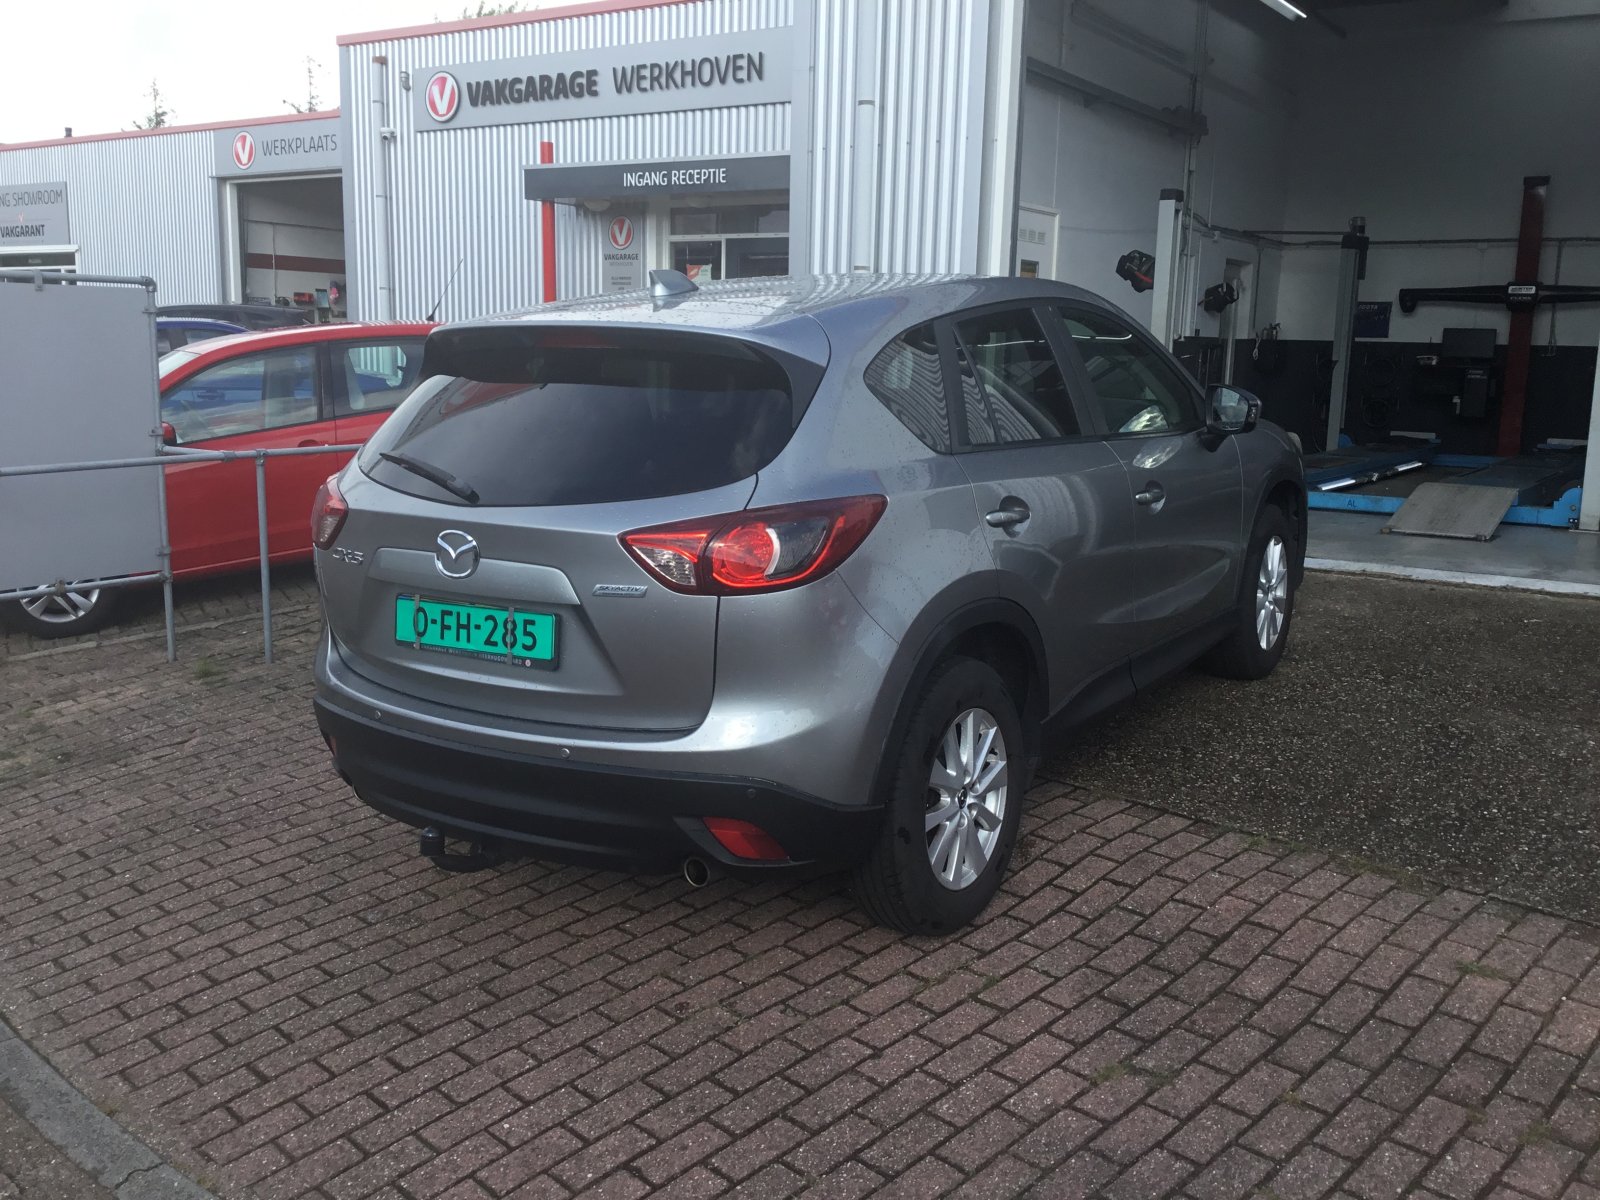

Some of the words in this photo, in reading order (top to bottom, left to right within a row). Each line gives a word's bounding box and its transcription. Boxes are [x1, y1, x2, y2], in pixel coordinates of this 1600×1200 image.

[467, 69, 599, 107] VAKGARAGE
[612, 51, 765, 95] WERKHOVEN
[262, 134, 338, 157] WERKPLAATS
[623, 170, 668, 187] INGANG
[671, 168, 727, 185] RECEPTIE
[12, 189, 63, 207] SHOWROOM
[0, 224, 45, 238] VAKGARANT
[603, 253, 639, 261] VAKGARAGE
